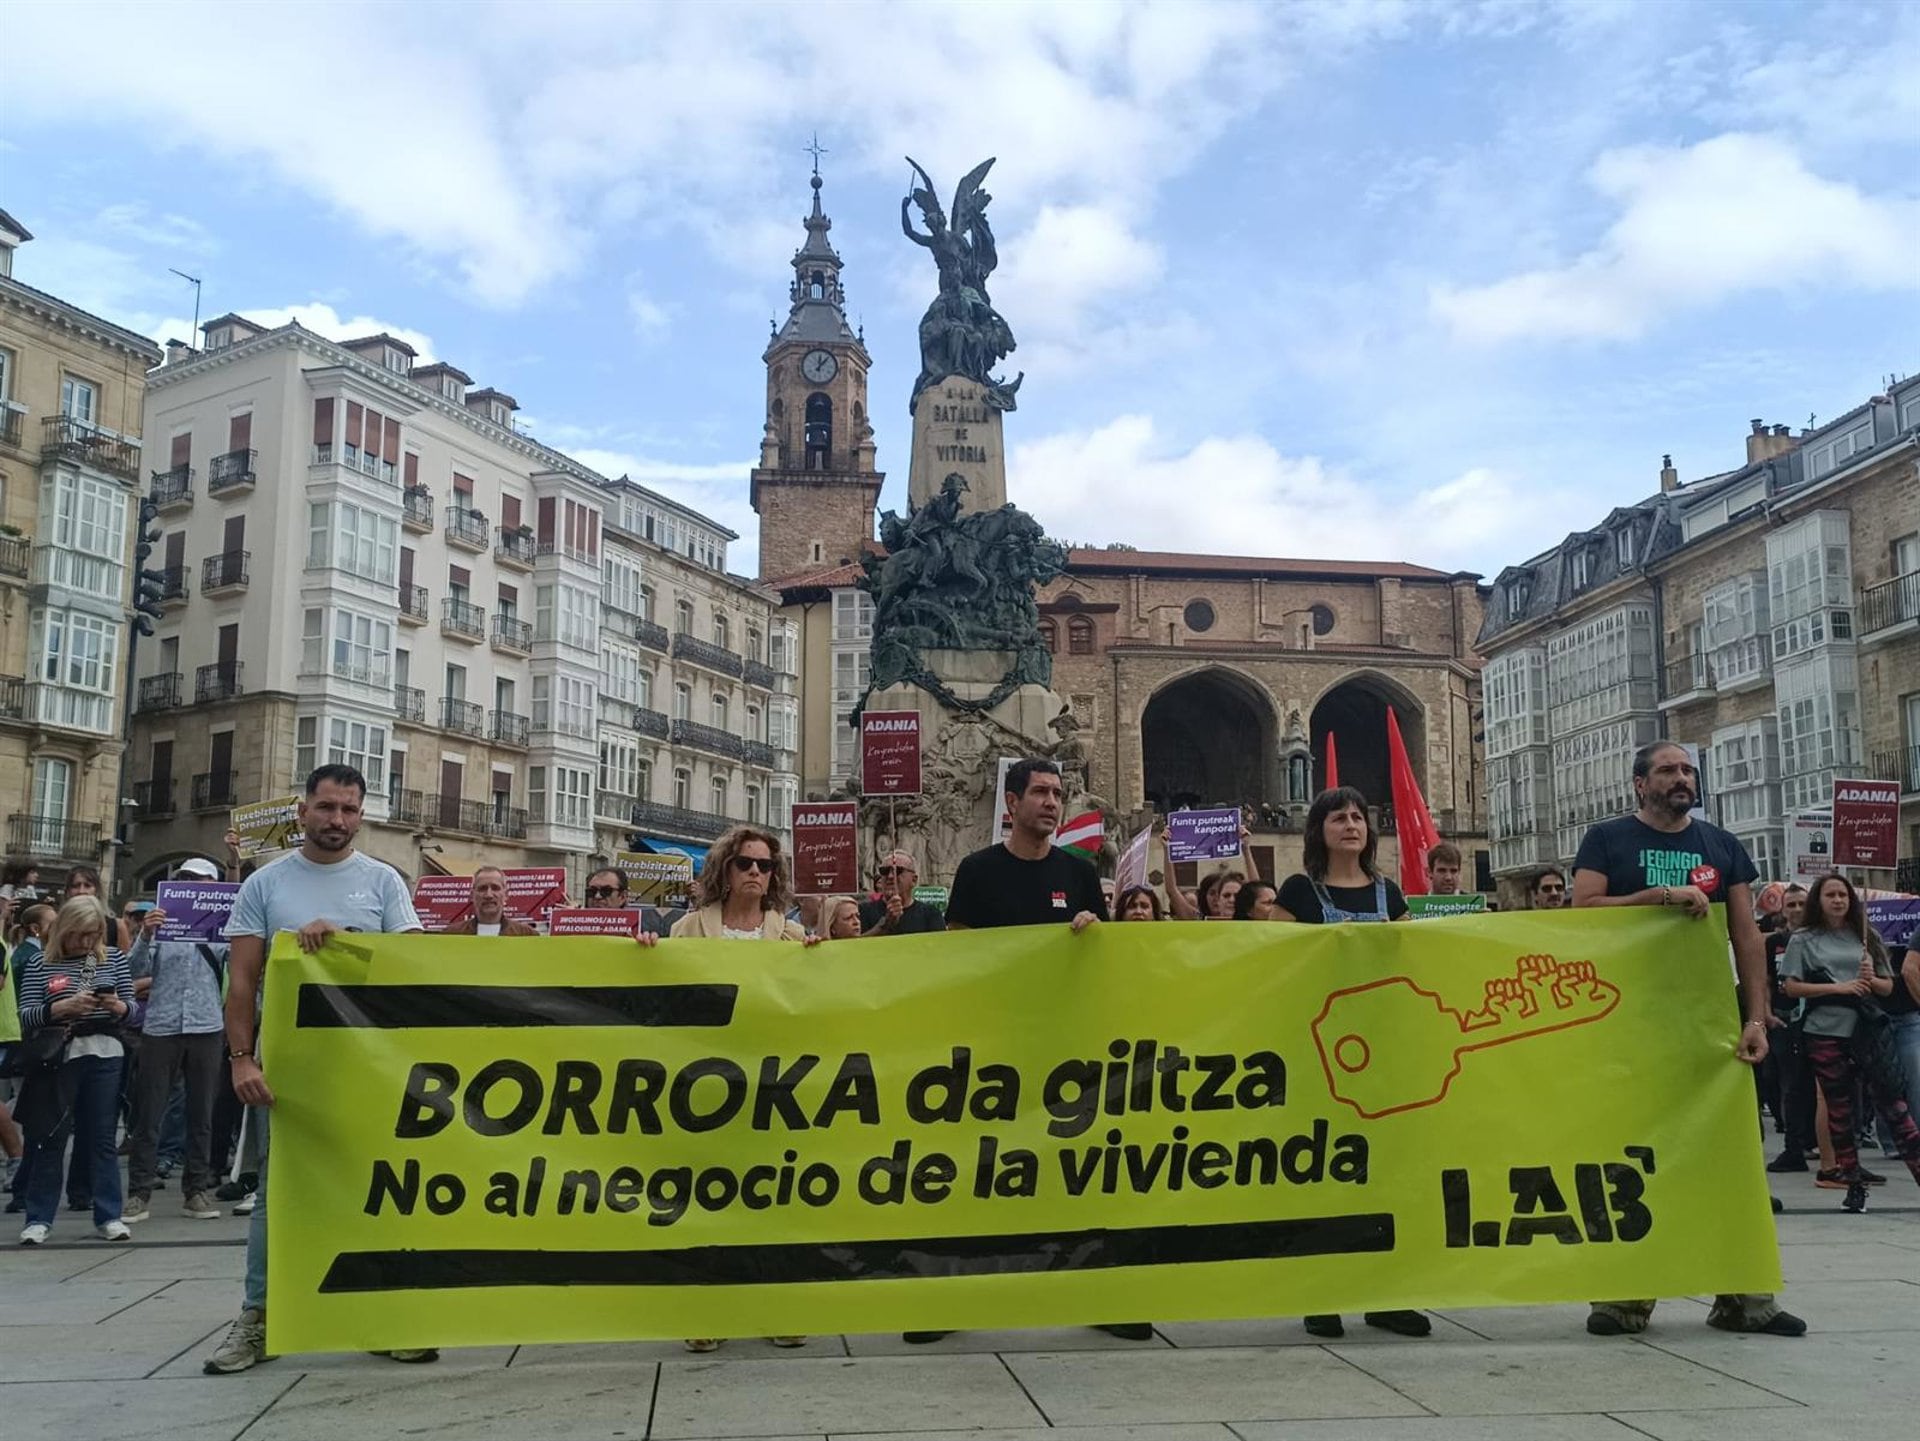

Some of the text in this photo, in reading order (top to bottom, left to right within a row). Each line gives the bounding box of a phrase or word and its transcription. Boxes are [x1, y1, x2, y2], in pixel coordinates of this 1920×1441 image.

[960, 388, 974, 400] LA
[933, 405, 989, 423] BATALLA
[955, 428, 968, 440] DE
[936, 445, 986, 462] VITORIA
[865, 720, 918, 731] ADANIA
[1837, 789, 1897, 802] ADANIA
[235, 803, 299, 822] Etxebizitzare
[795, 812, 854, 825] ADANIA
[1172, 815, 1234, 827] Funts putreak
[619, 858, 689, 872] Etxebizitzaren
[625, 870, 659, 880] rezioa
[1692, 868, 1715, 883] LAB
[164, 888, 238, 901] Funts putrea
[192, 900, 234, 912] kanpor
[1425, 902, 1481, 911] Etxegabetze
[396, 1039, 1286, 1138] BORROKA da giltza
[364, 1119, 1368, 1226] No al negocio de la vivienda
